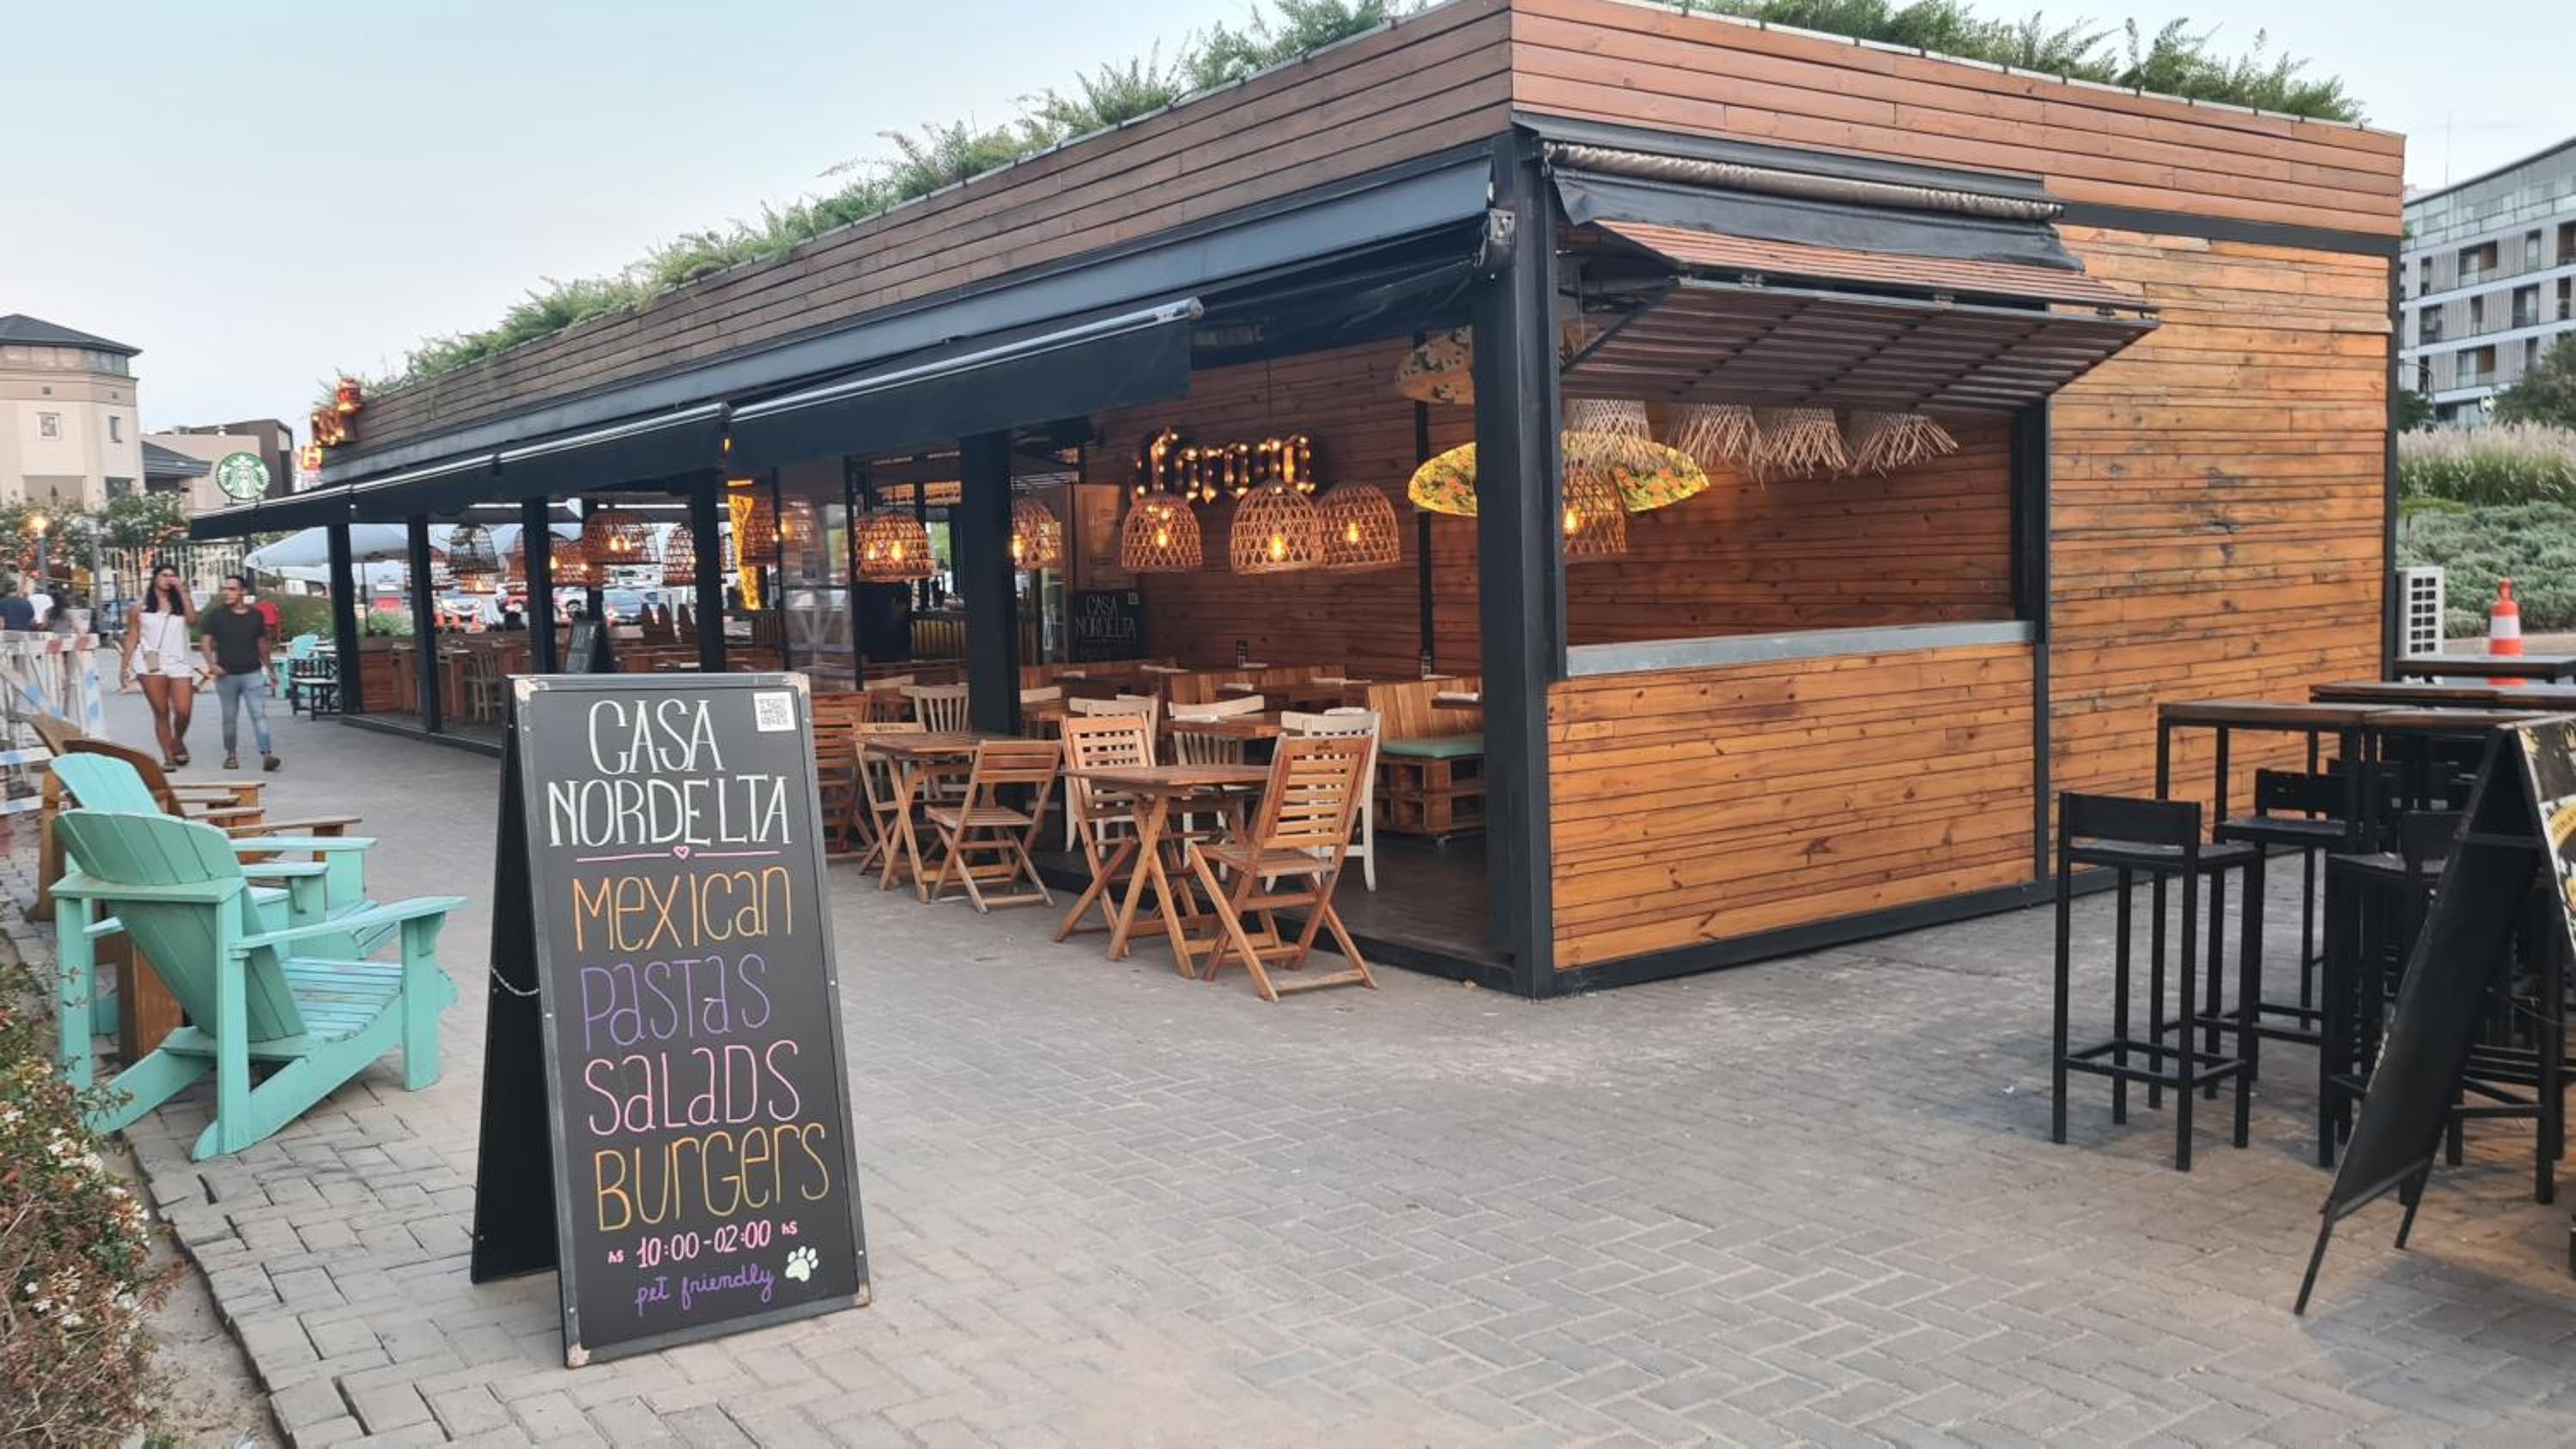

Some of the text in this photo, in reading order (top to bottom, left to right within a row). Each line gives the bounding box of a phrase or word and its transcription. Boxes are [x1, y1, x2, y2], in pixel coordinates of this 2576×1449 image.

[588, 699, 726, 774] CASA
[546, 774, 792, 847] NORDELTA
[635, 1263, 775, 1318] pet friendly
